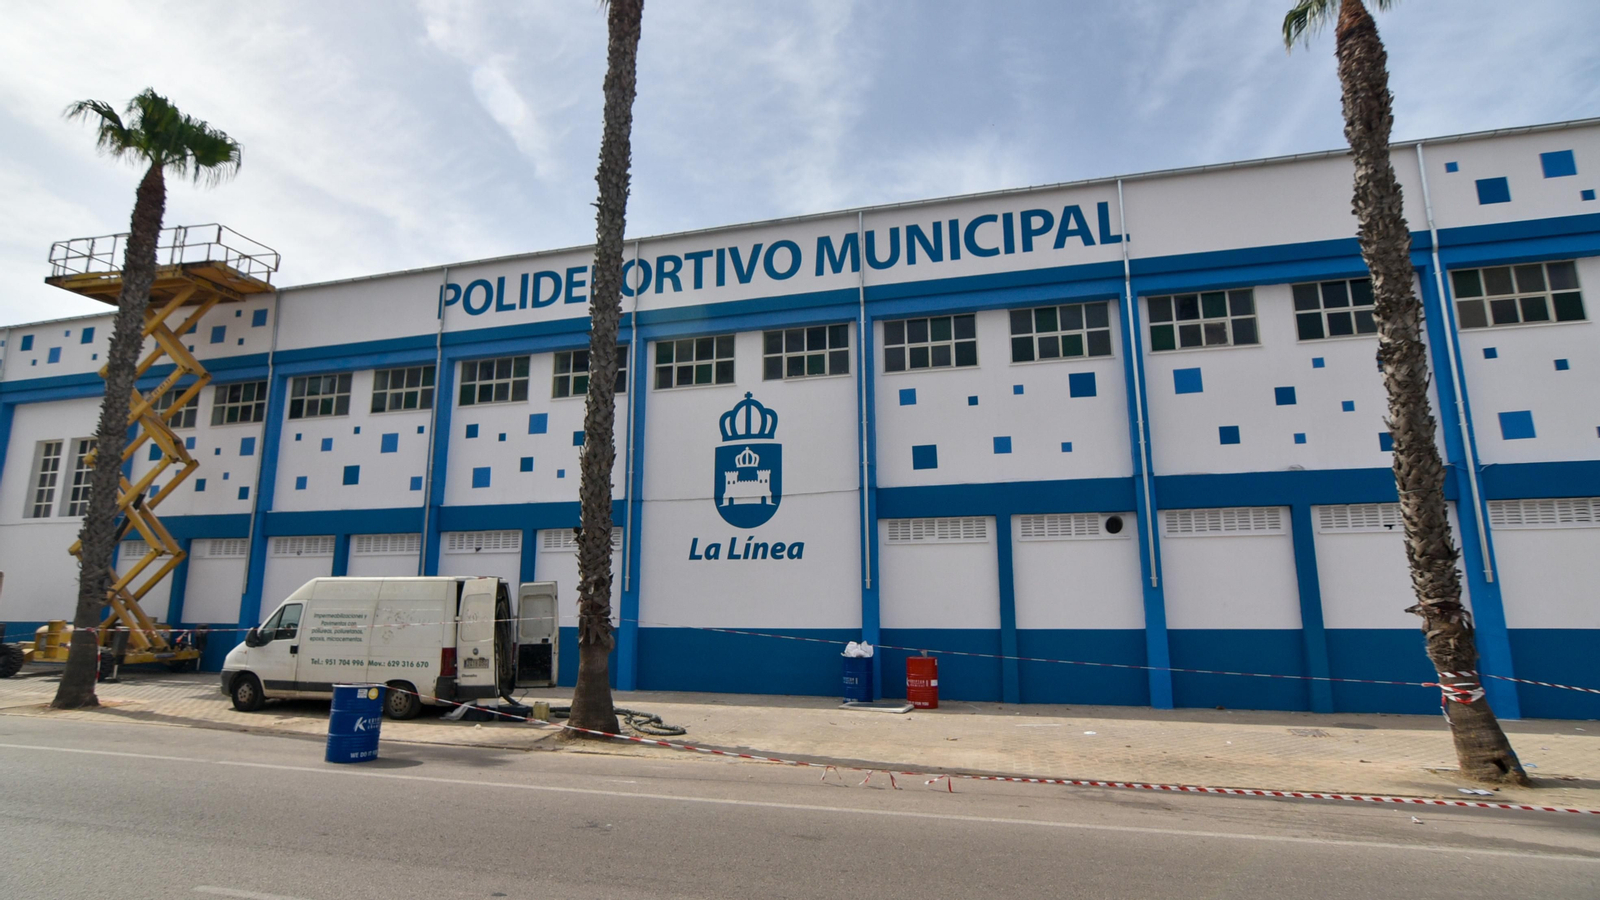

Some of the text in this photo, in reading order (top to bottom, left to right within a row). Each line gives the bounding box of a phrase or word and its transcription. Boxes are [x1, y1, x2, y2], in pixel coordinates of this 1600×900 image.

[438, 201, 1130, 319] POLIDEORTIVO MUNICIPAL
[689, 535, 805, 560] La Línea
[325, 658, 337, 666] 951
[338, 659, 351, 667] 704
[352, 659, 365, 667] 996
[387, 660, 400, 668] 629
[402, 660, 414, 668] 316
